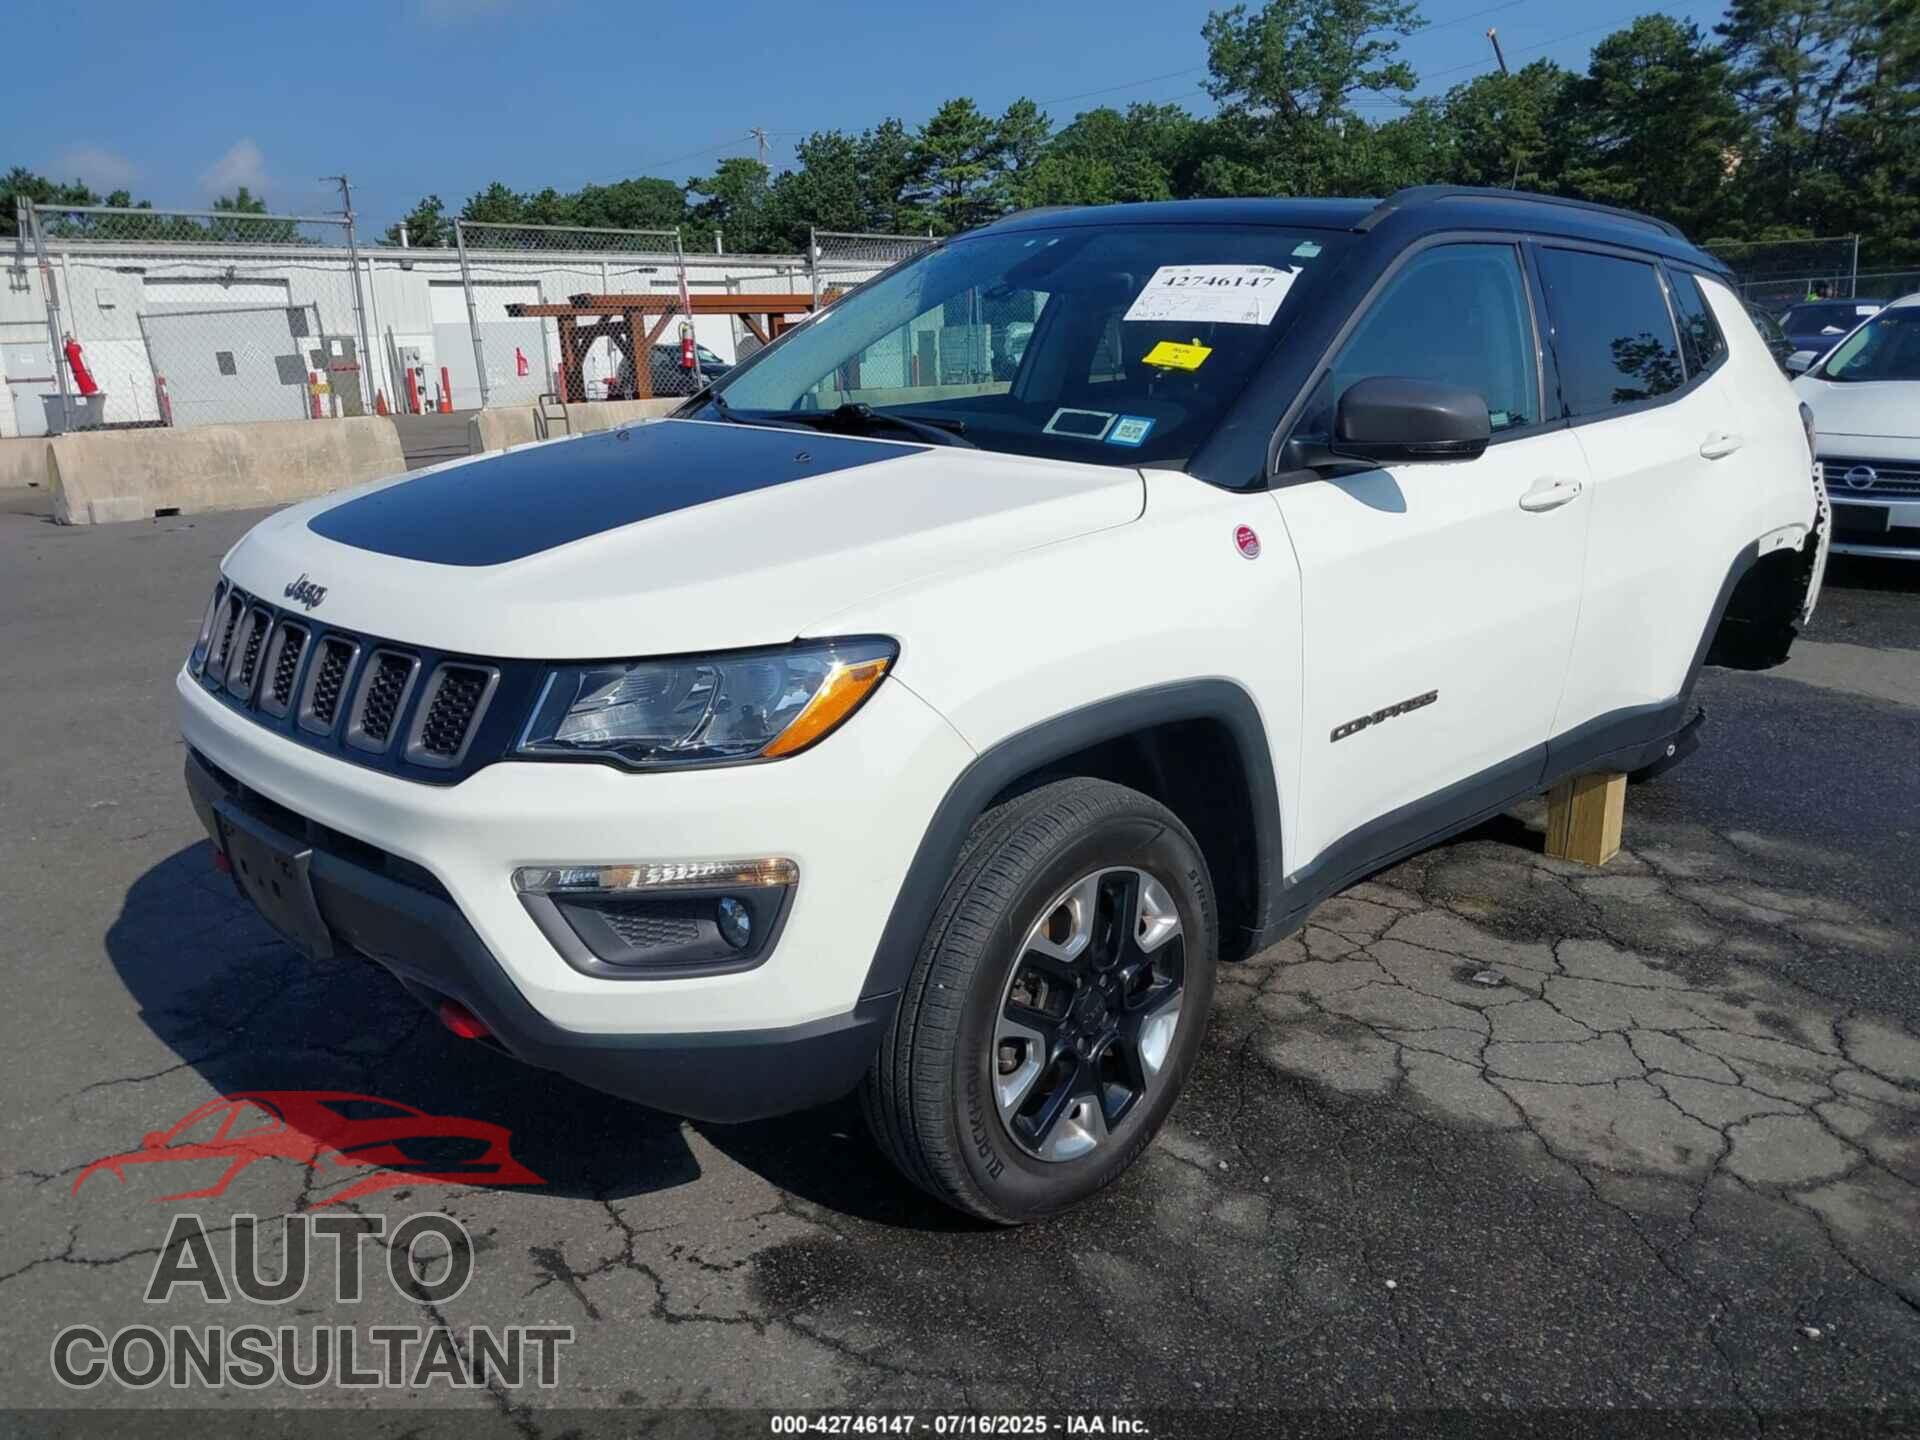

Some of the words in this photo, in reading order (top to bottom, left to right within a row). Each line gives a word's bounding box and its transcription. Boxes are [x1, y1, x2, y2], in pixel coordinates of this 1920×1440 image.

[1161, 275, 1276, 288] 42746147
[283, 572, 328, 612] Jeep
[1329, 688, 1439, 743] COMPASS
